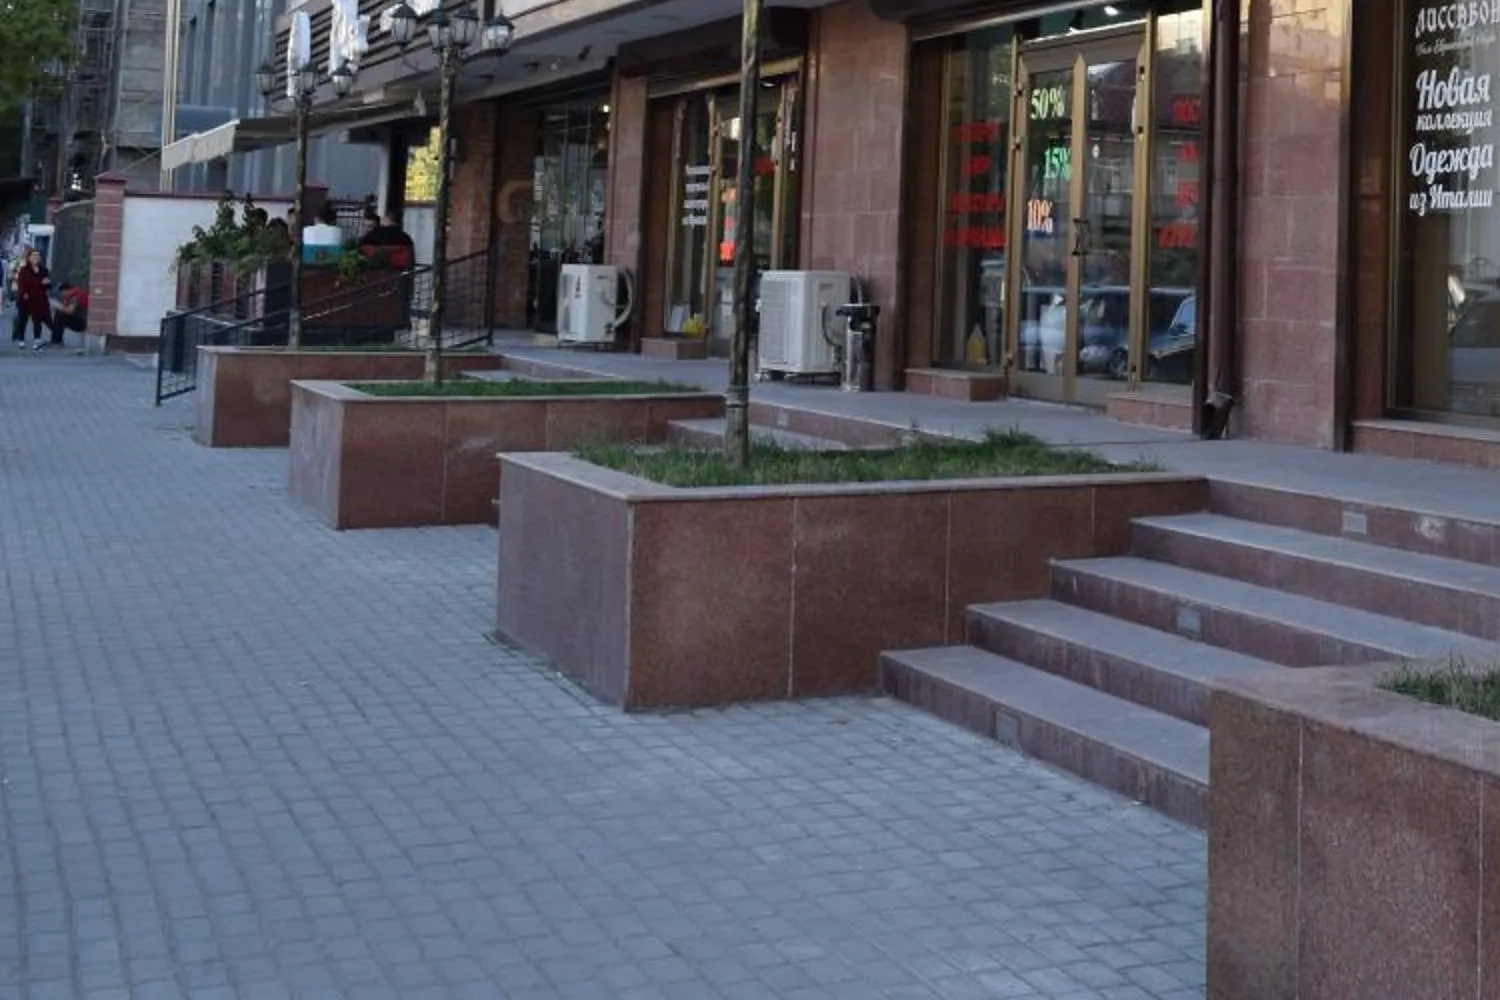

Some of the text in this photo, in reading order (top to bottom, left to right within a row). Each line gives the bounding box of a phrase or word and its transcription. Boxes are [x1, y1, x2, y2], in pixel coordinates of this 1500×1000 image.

[1030, 84, 1065, 121] 50%
[1416, 66, 1491, 109] Новая
[1416, 109, 1493, 134] коллекция
[1044, 147, 1072, 181] 15%
[1409, 142, 1494, 184] Одежда
[1409, 183, 1493, 216] из Италии
